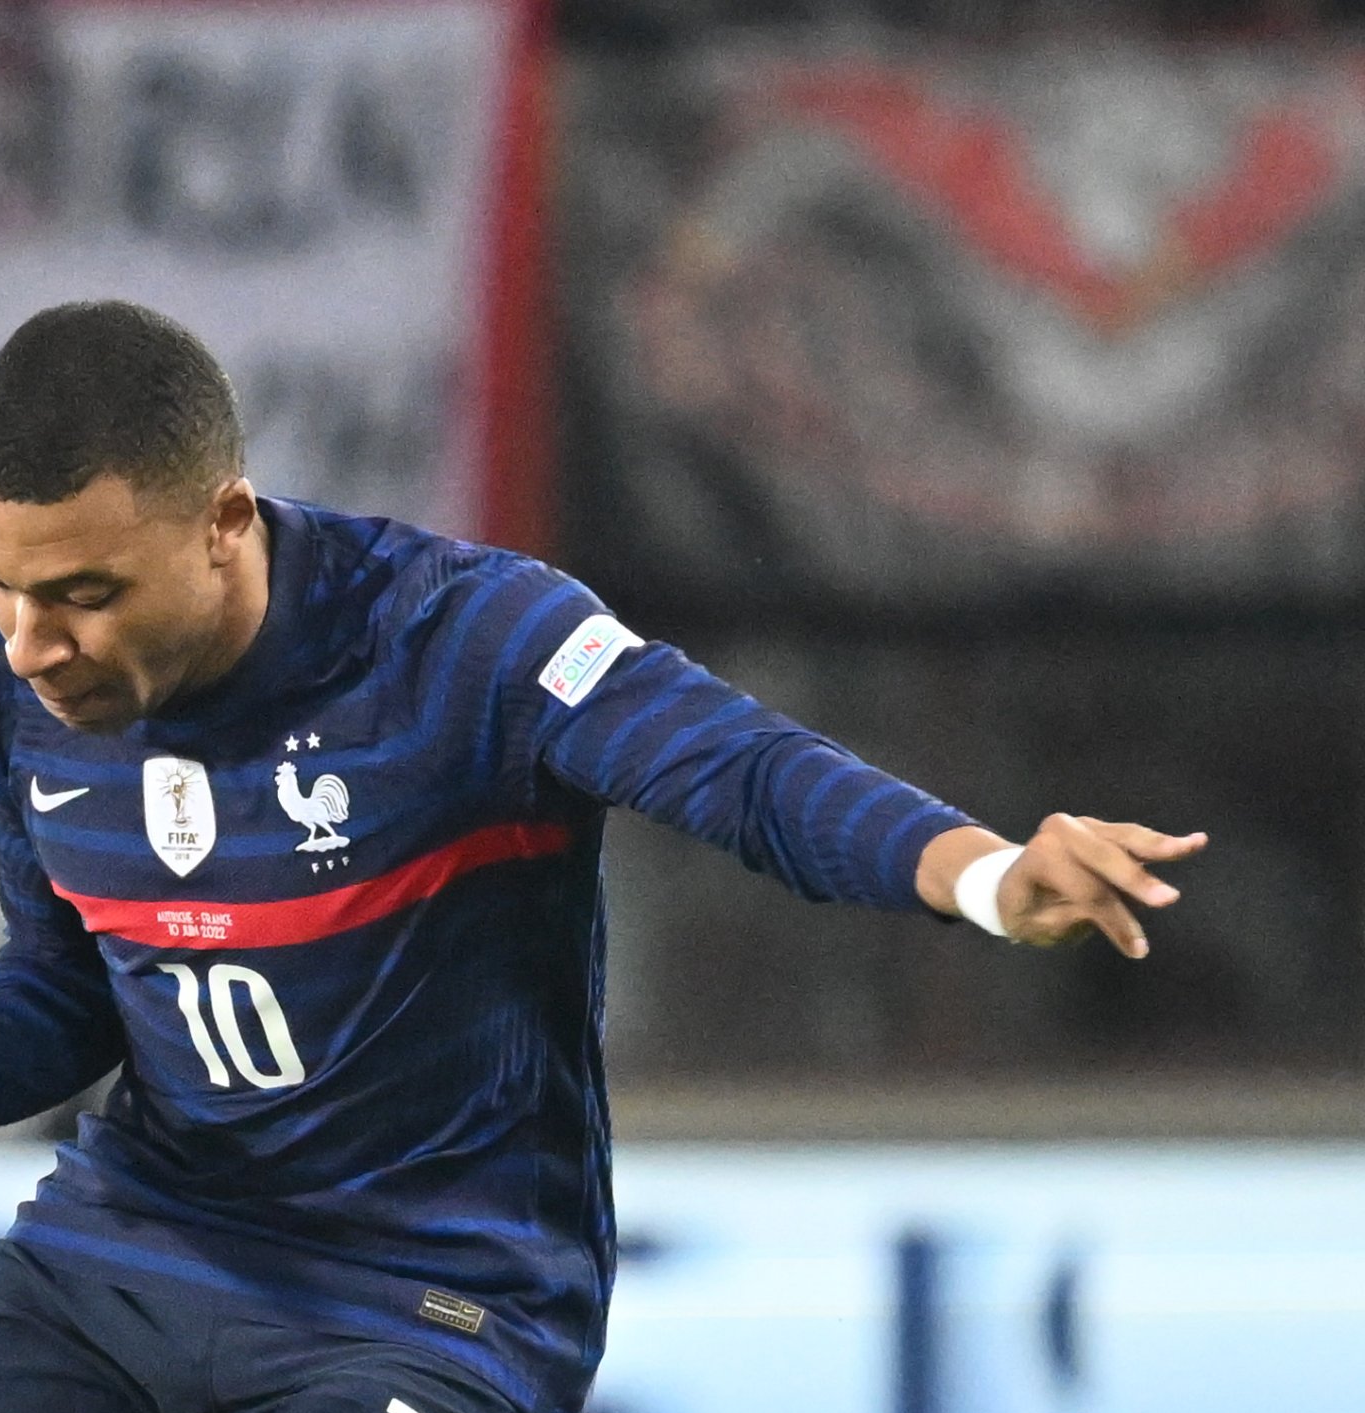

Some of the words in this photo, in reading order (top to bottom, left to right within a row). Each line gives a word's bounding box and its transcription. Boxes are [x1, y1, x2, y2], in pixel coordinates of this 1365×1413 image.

[168, 832, 197, 845] FIFA
[200, 925, 228, 939] 2022
[155, 963, 305, 1089] 10
